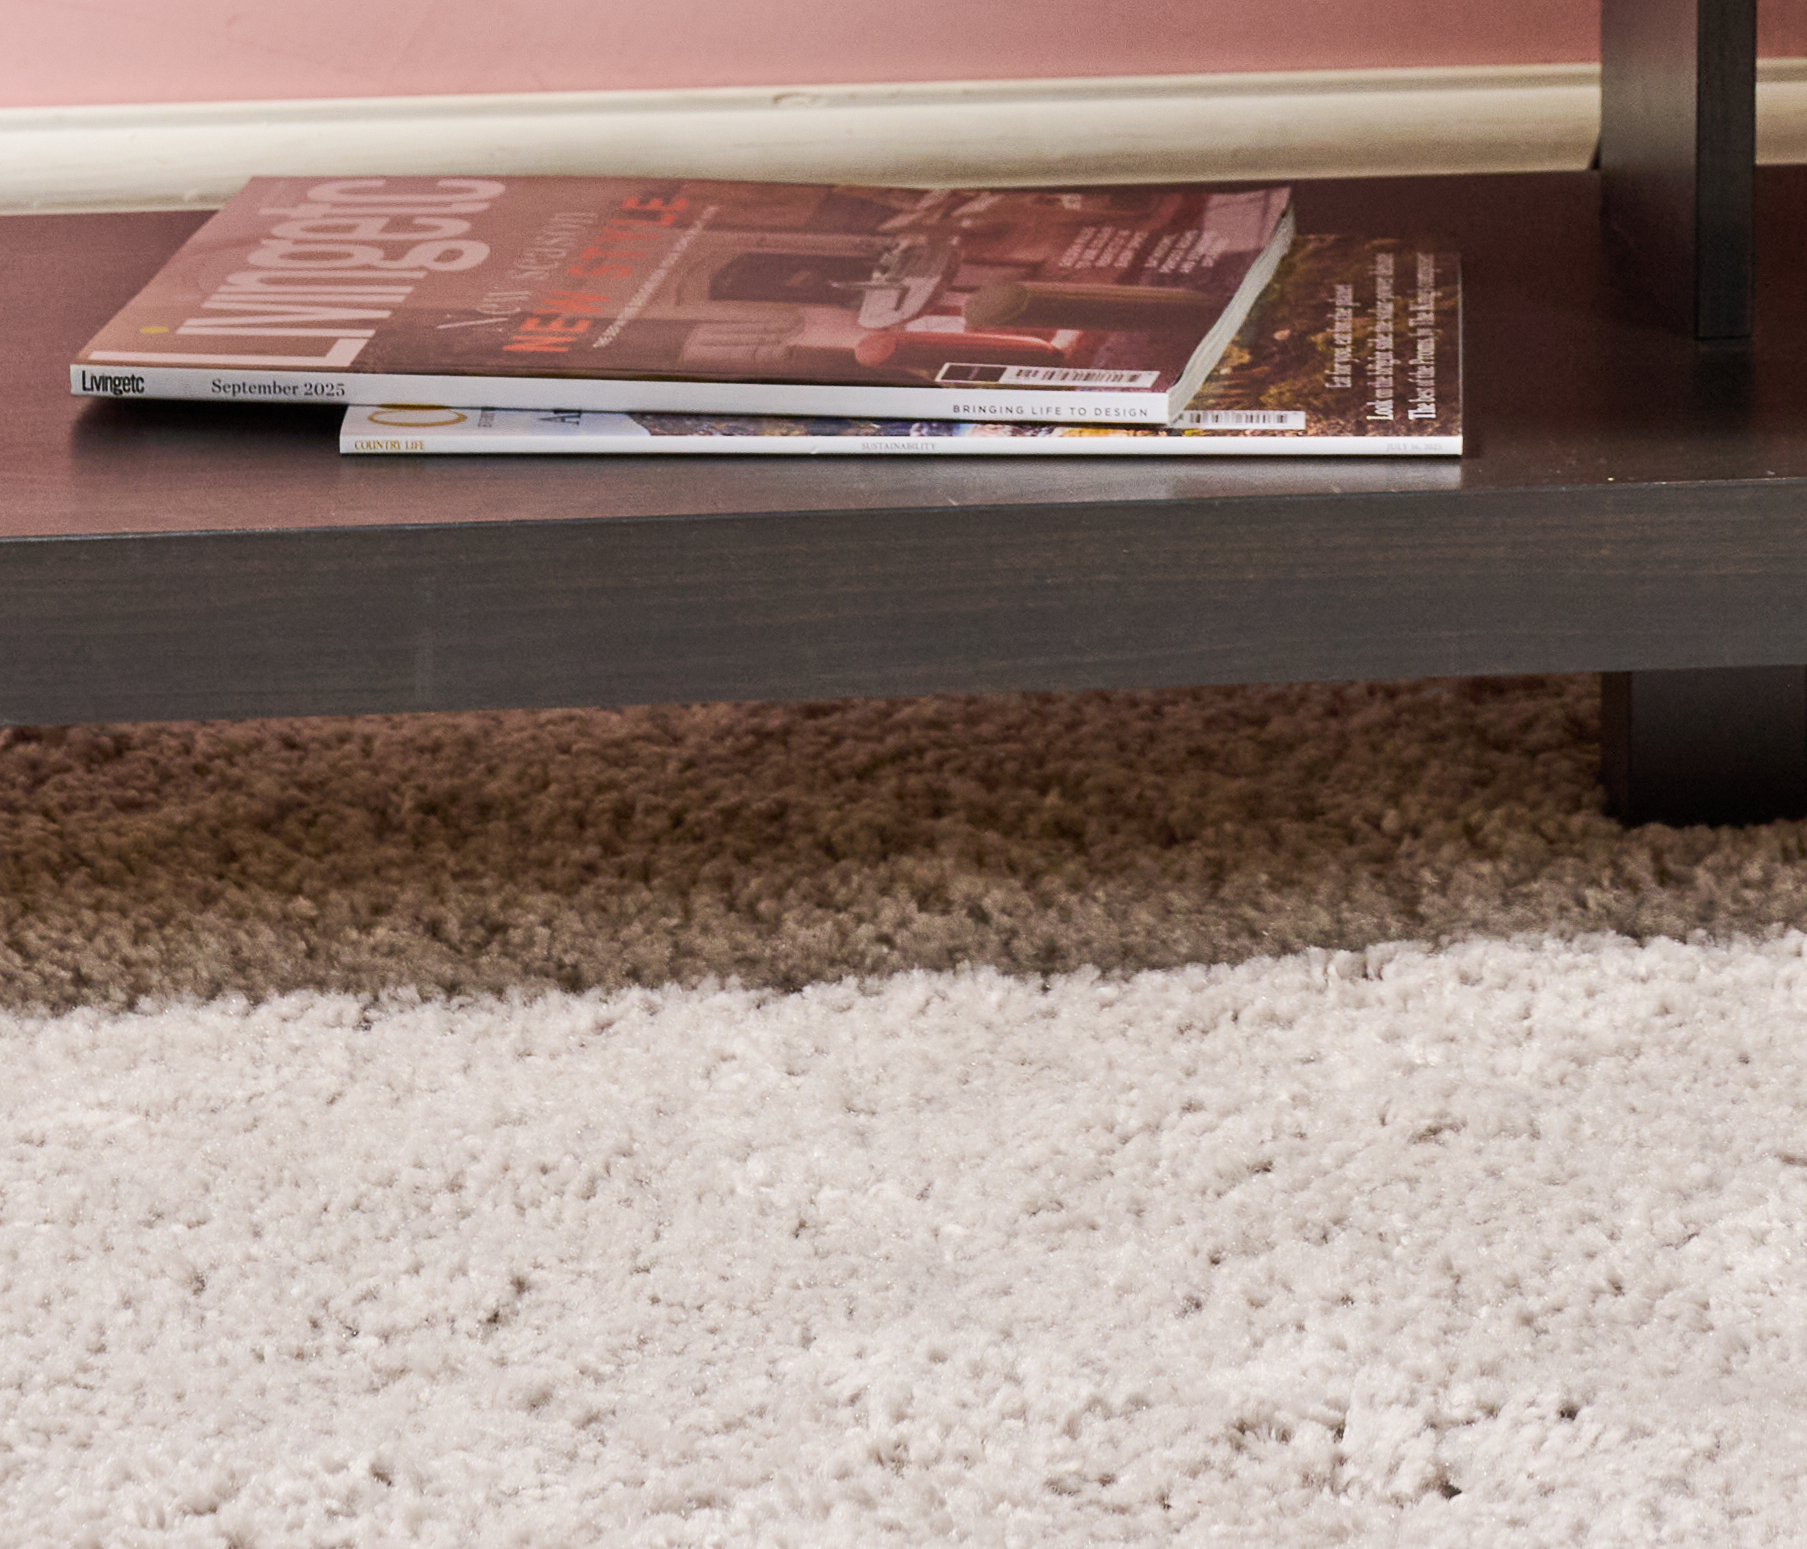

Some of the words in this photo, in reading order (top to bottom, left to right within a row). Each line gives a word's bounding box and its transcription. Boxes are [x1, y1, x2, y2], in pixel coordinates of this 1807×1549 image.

[503, 289, 610, 353] NEW
[567, 195, 690, 279] STYLE
[81, 371, 145, 395] Livingetc
[211, 378, 298, 398] September
[303, 381, 346, 398] 2025
[953, 404, 1026, 416] BRINGING
[1031, 405, 1063, 417] LIFE
[1069, 406, 1087, 417] TO
[1093, 407, 1149, 418] DESIGN
[1366, 399, 1393, 419] Look
[1408, 402, 1436, 419] The
[354, 440, 401, 450] COUNTRY
[405, 440, 424, 450] LIFE
[861, 442, 936, 450] SUSTAINABILITY
